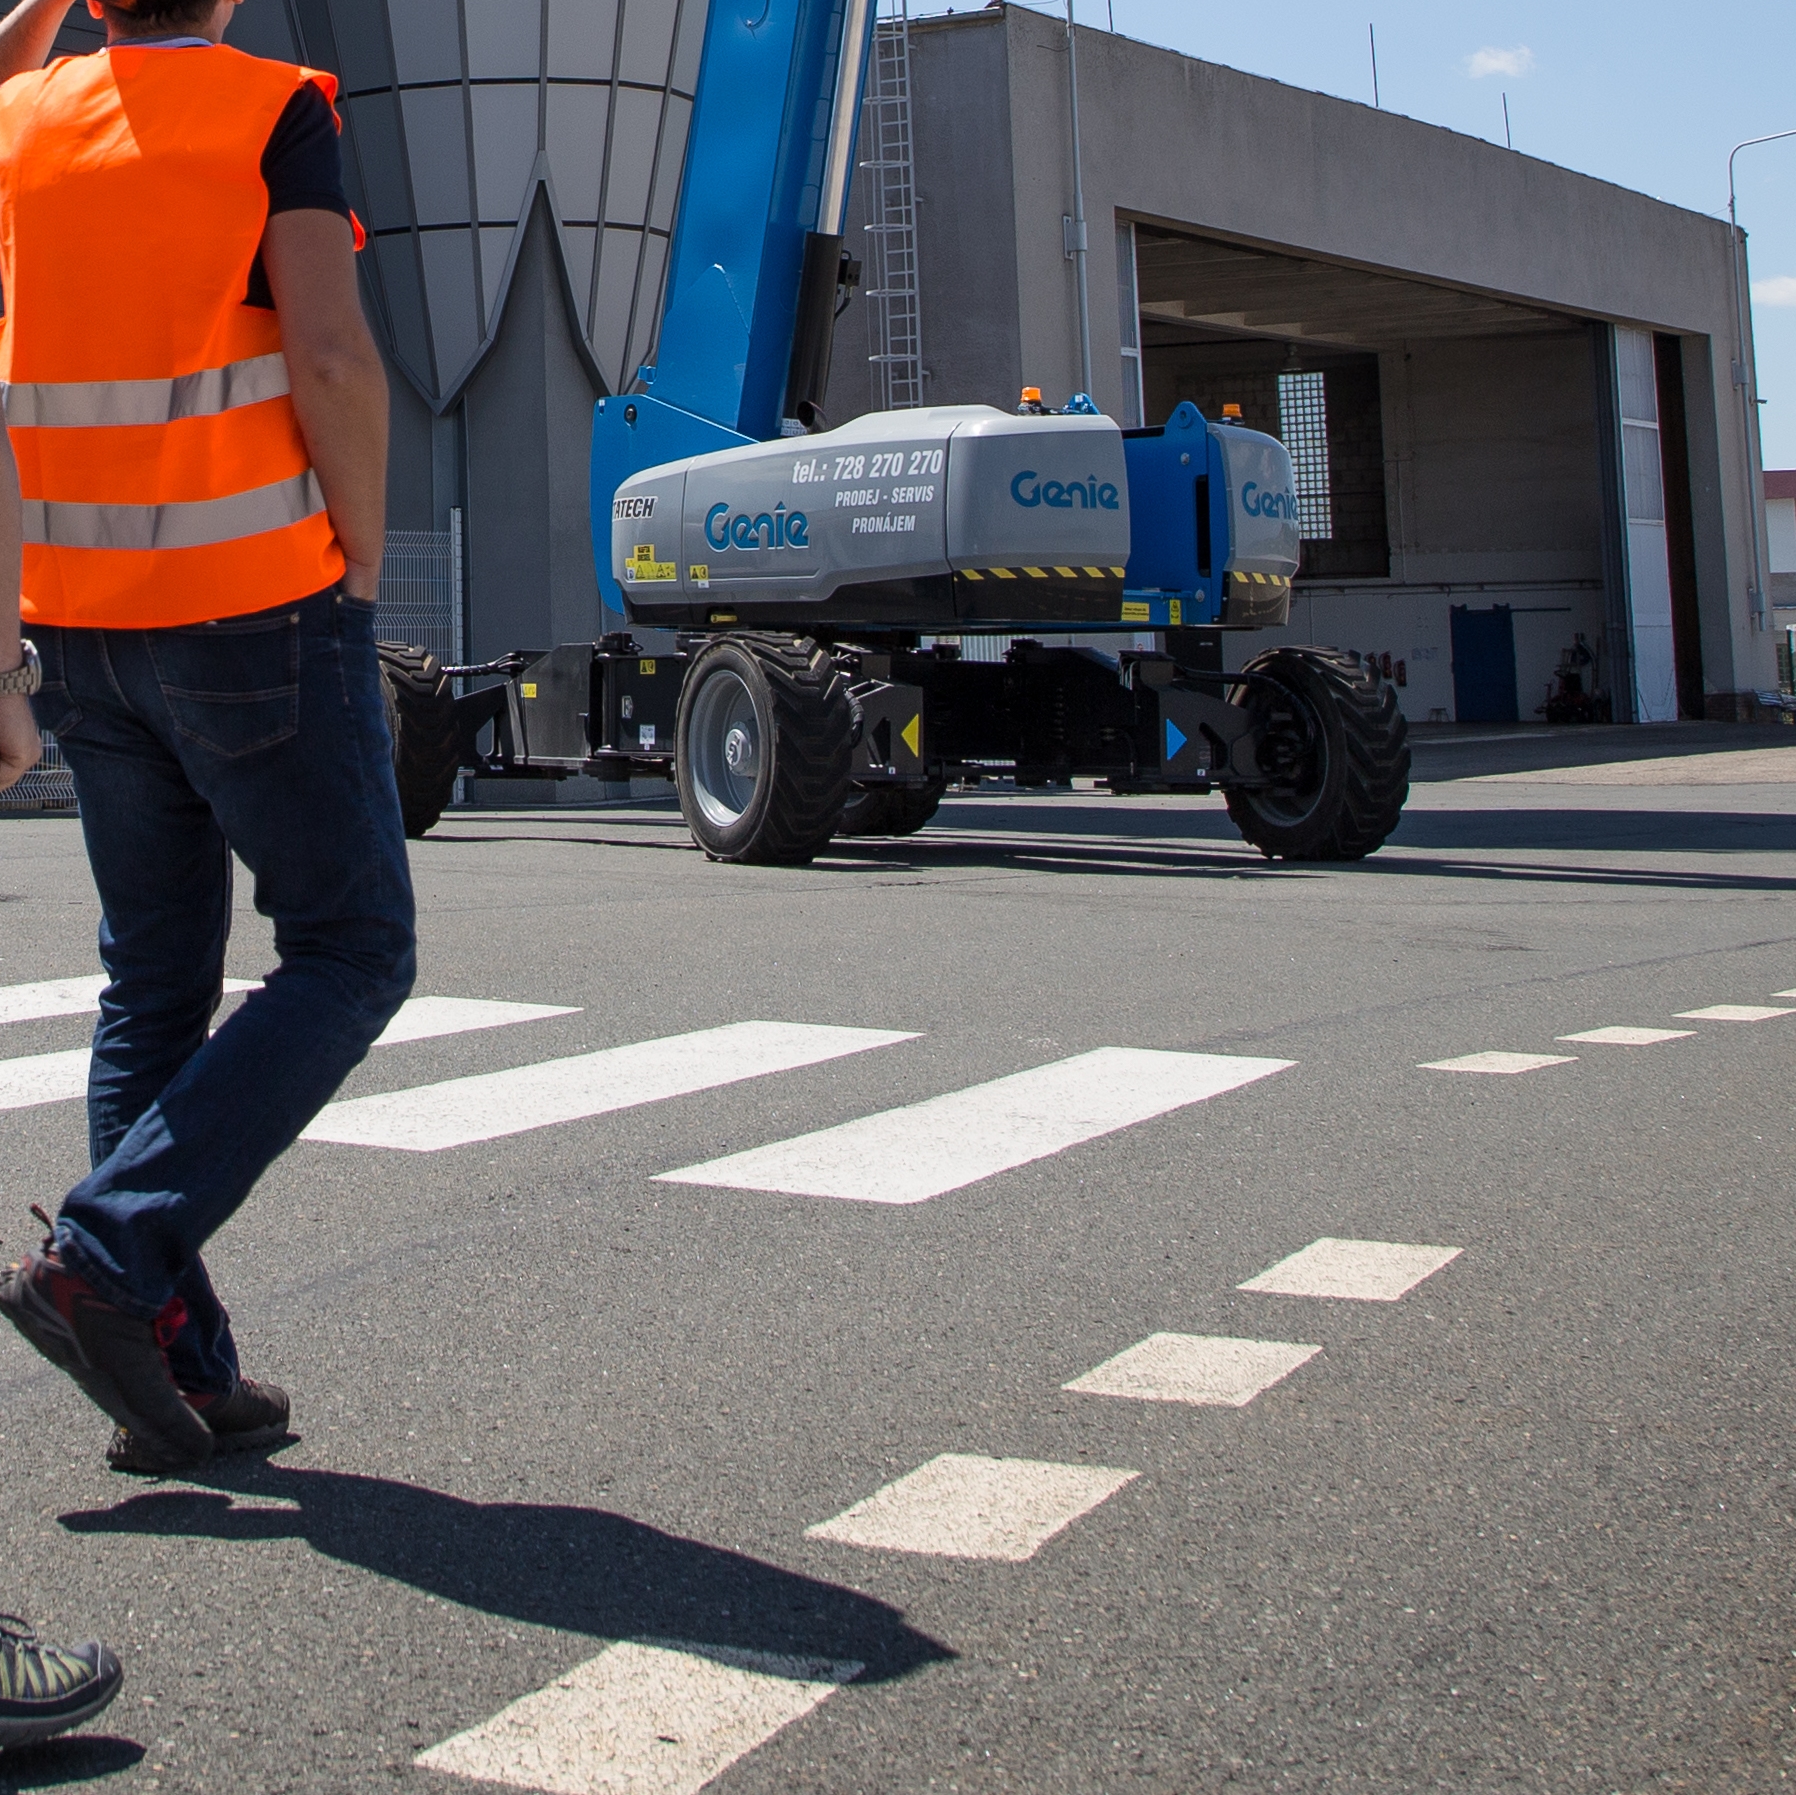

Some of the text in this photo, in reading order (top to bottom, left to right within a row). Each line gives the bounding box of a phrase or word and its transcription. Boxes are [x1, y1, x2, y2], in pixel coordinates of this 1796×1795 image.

[792, 448, 944, 484] tel.: 728 270 270
[835, 488, 879, 508] PRODEJ
[891, 484, 934, 505] SERVIS
[1010, 469, 1119, 510] Genie
[1241, 481, 1299, 521] Genie
[613, 497, 656, 520] TATECH
[704, 501, 809, 552] Genie
[852, 512, 915, 534] PRONÁJEM
